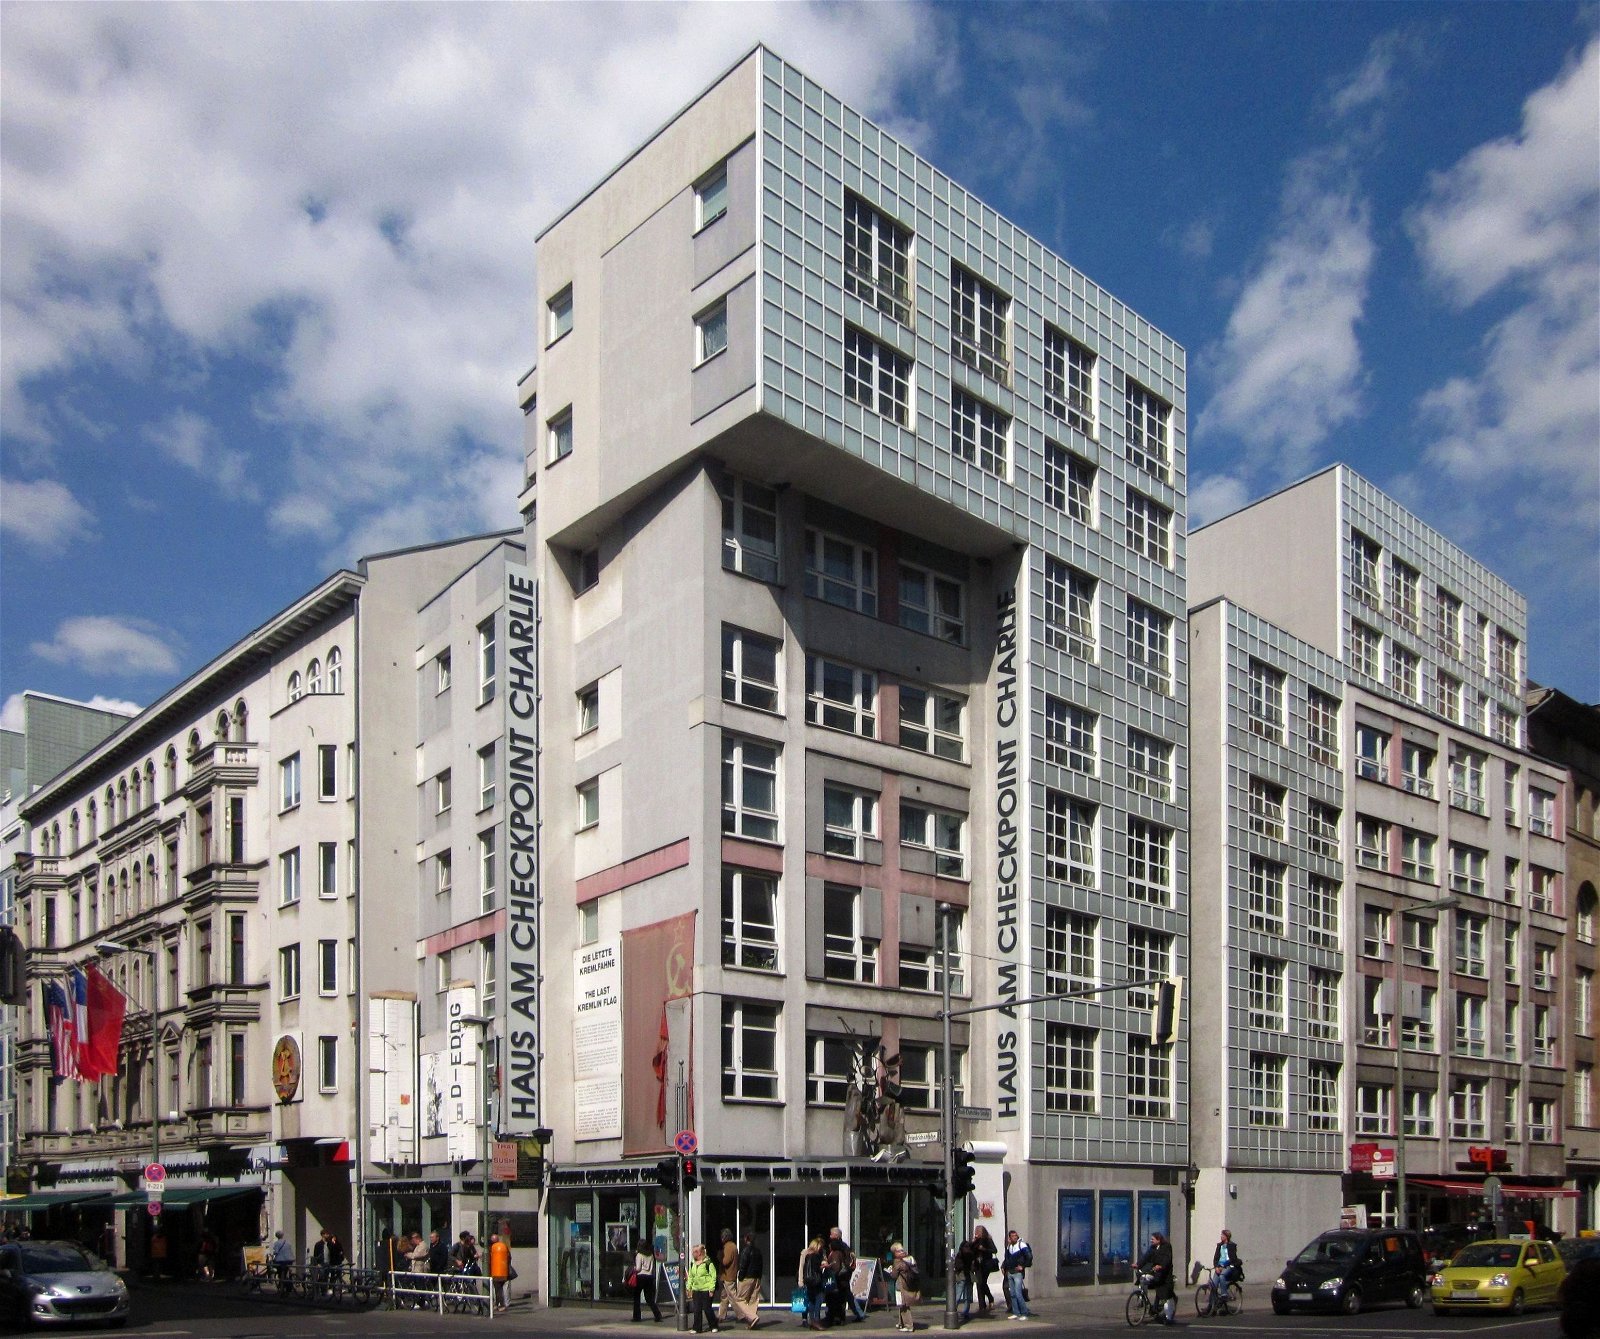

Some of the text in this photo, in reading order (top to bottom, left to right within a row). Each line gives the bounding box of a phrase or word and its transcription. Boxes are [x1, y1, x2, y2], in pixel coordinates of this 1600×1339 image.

[509, 573, 535, 1119] HAUS AM CHECKPOINT CHARLIE
[996, 585, 1018, 1119] HAUS AM CHECKPOINT CHARLIE
[582, 948, 612, 964] DIE LETZTE
[579, 959, 615, 976] KREMLFAHNE
[585, 986, 610, 1000] THE LAST
[577, 996, 617, 1013] KREMLIN FLAG
